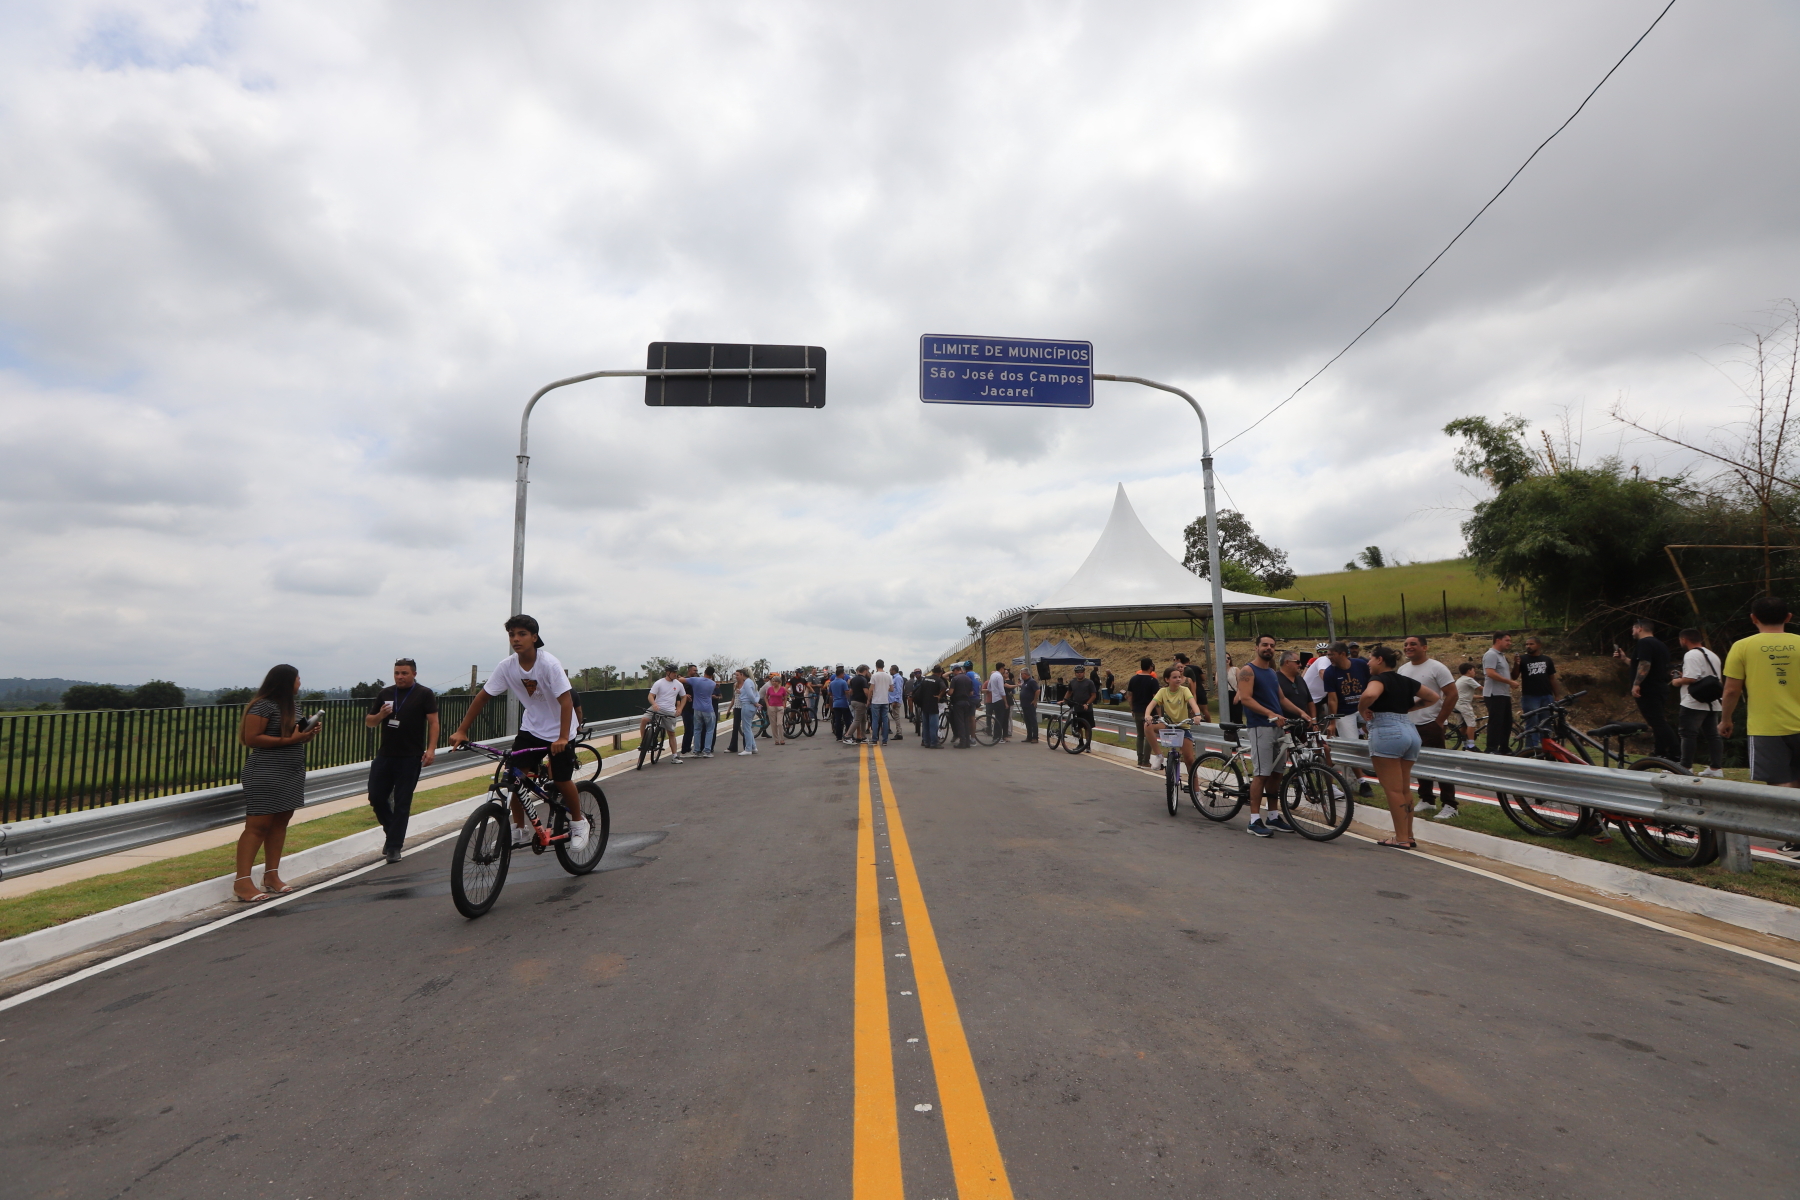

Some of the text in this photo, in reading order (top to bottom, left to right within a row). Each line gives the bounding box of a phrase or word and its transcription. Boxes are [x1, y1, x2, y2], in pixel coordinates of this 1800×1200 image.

[933, 343, 1089, 361] LIMITE DE MUNICÍPIOS
[930, 367, 1084, 385] São José dos Campos
[980, 385, 1034, 397] Jacareí
